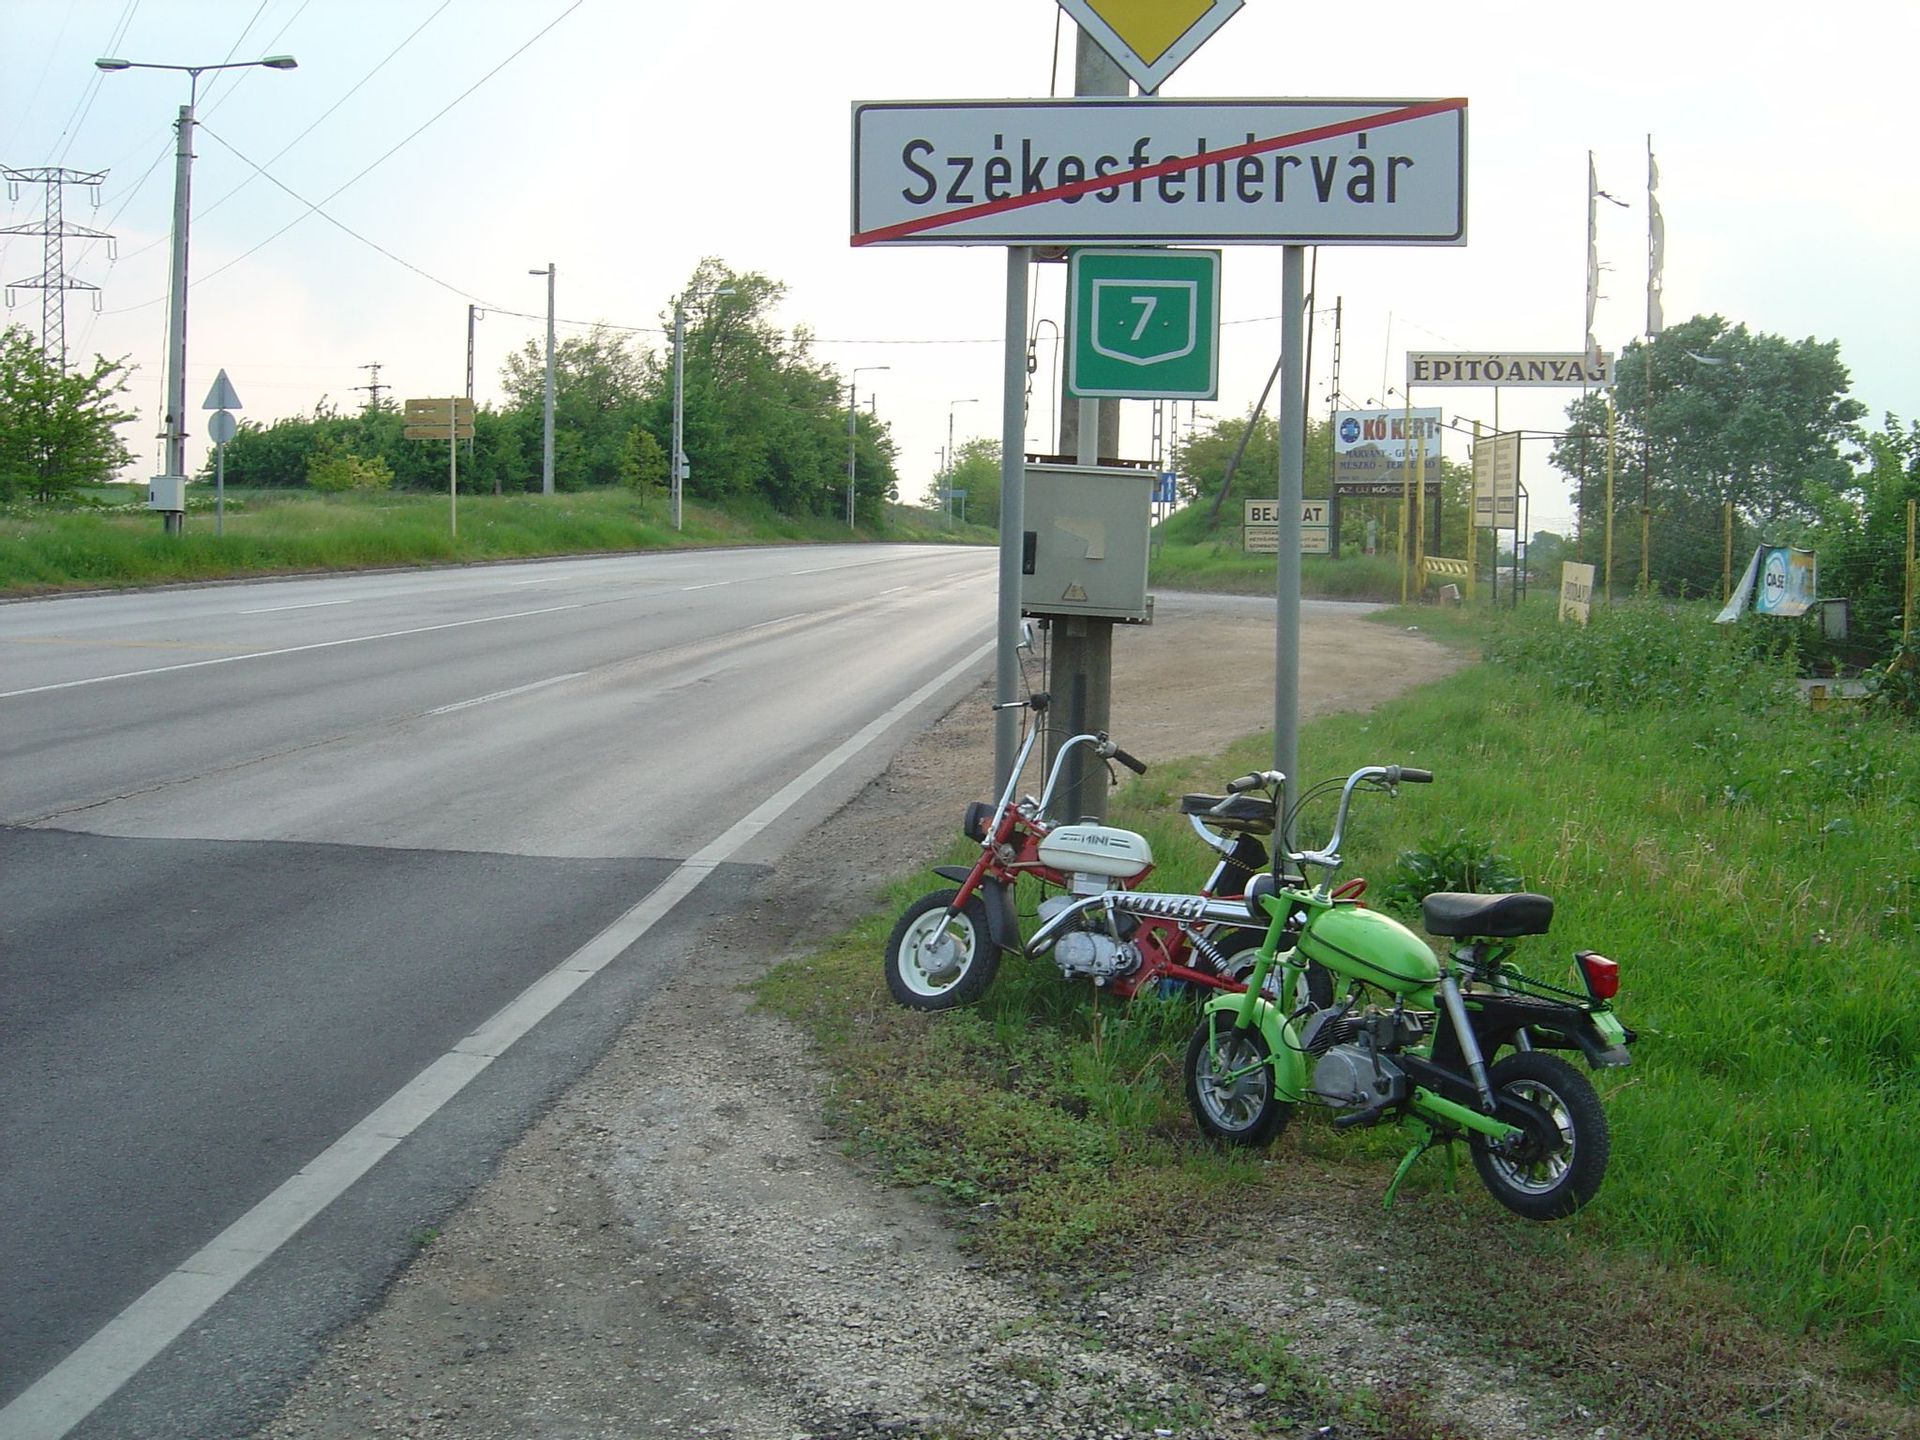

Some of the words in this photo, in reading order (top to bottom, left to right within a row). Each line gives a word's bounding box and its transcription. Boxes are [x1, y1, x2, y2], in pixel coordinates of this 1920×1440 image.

[901, 132, 1414, 205] Székesfehérvár
[1130, 296, 1157, 341] 7
[1413, 355, 1606, 382] ÉPÍTŐANYAG
[1251, 507, 1322, 521] BEJAT
